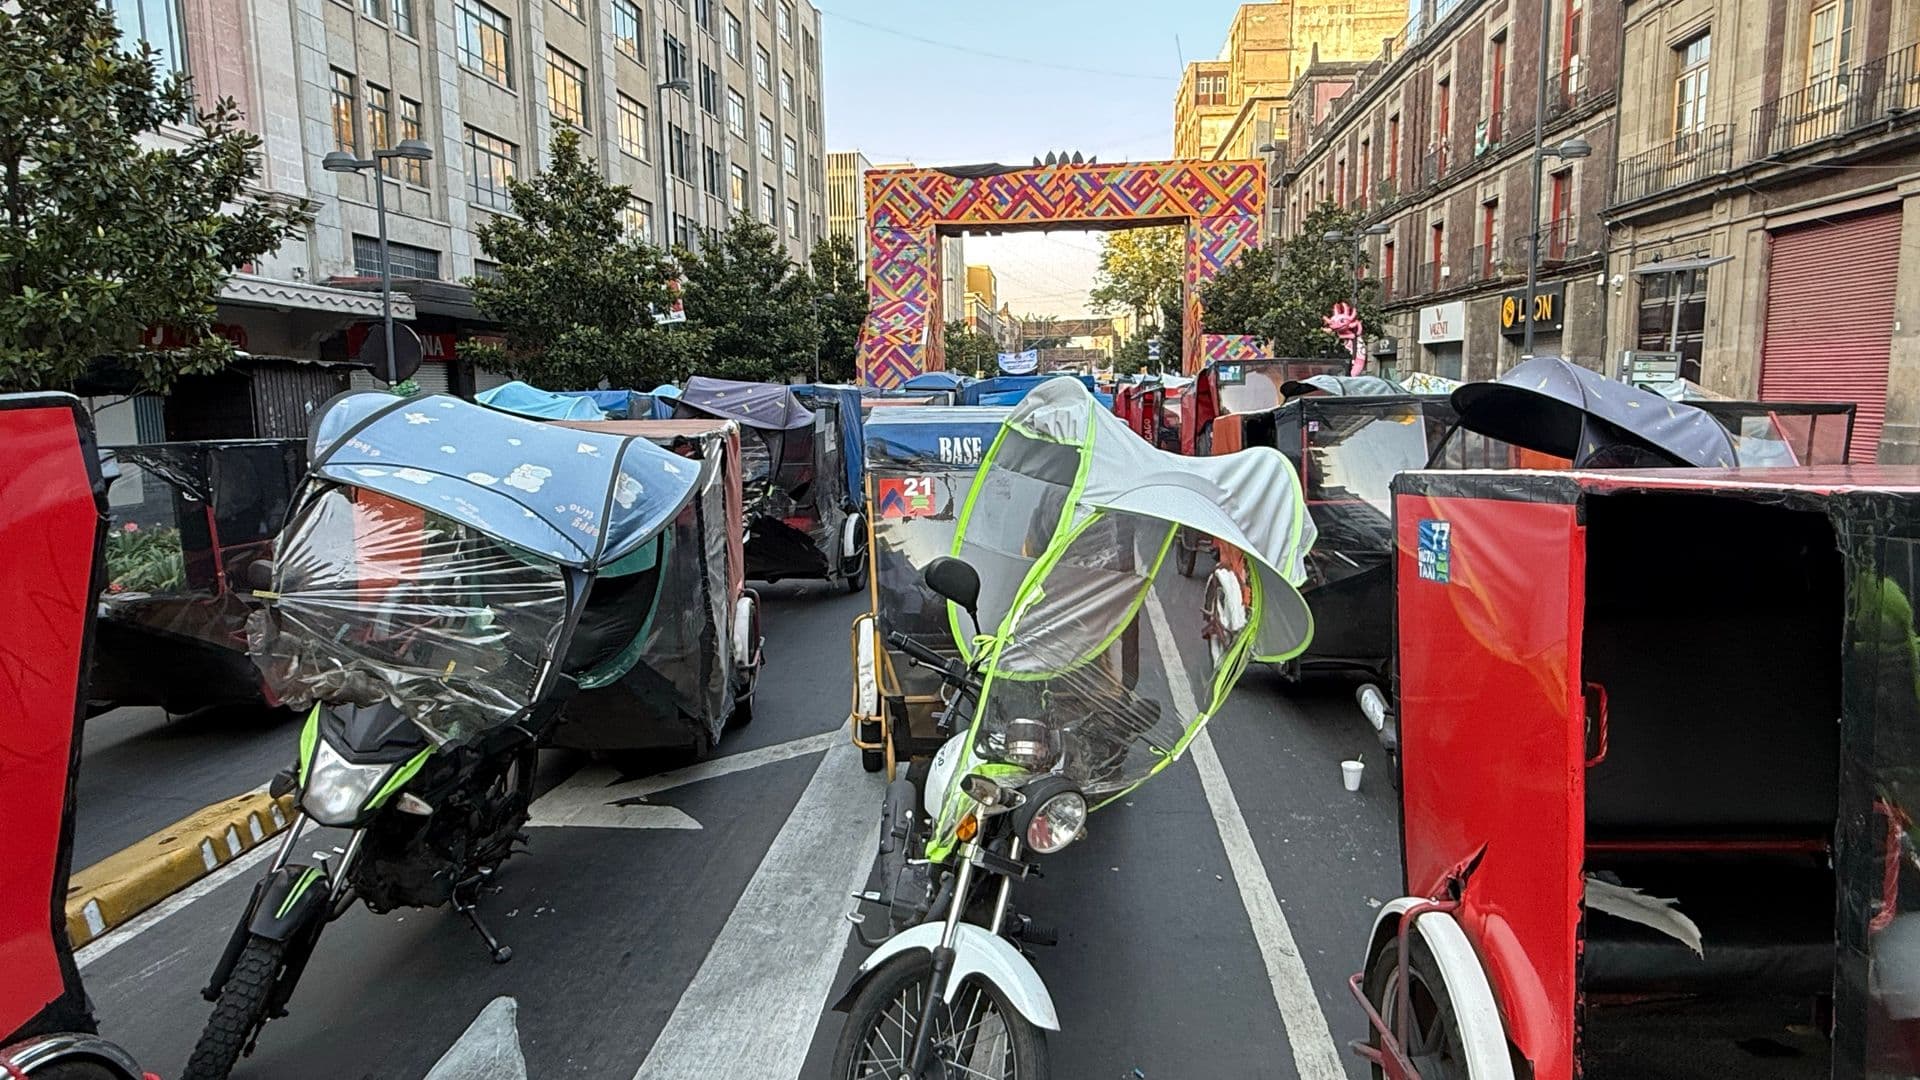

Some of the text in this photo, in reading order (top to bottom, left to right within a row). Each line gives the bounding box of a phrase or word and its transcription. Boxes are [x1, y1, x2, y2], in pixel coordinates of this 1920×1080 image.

[1518, 294, 1552, 322] LON
[939, 437, 982, 464] BASE
[903, 477, 931, 497] 21
